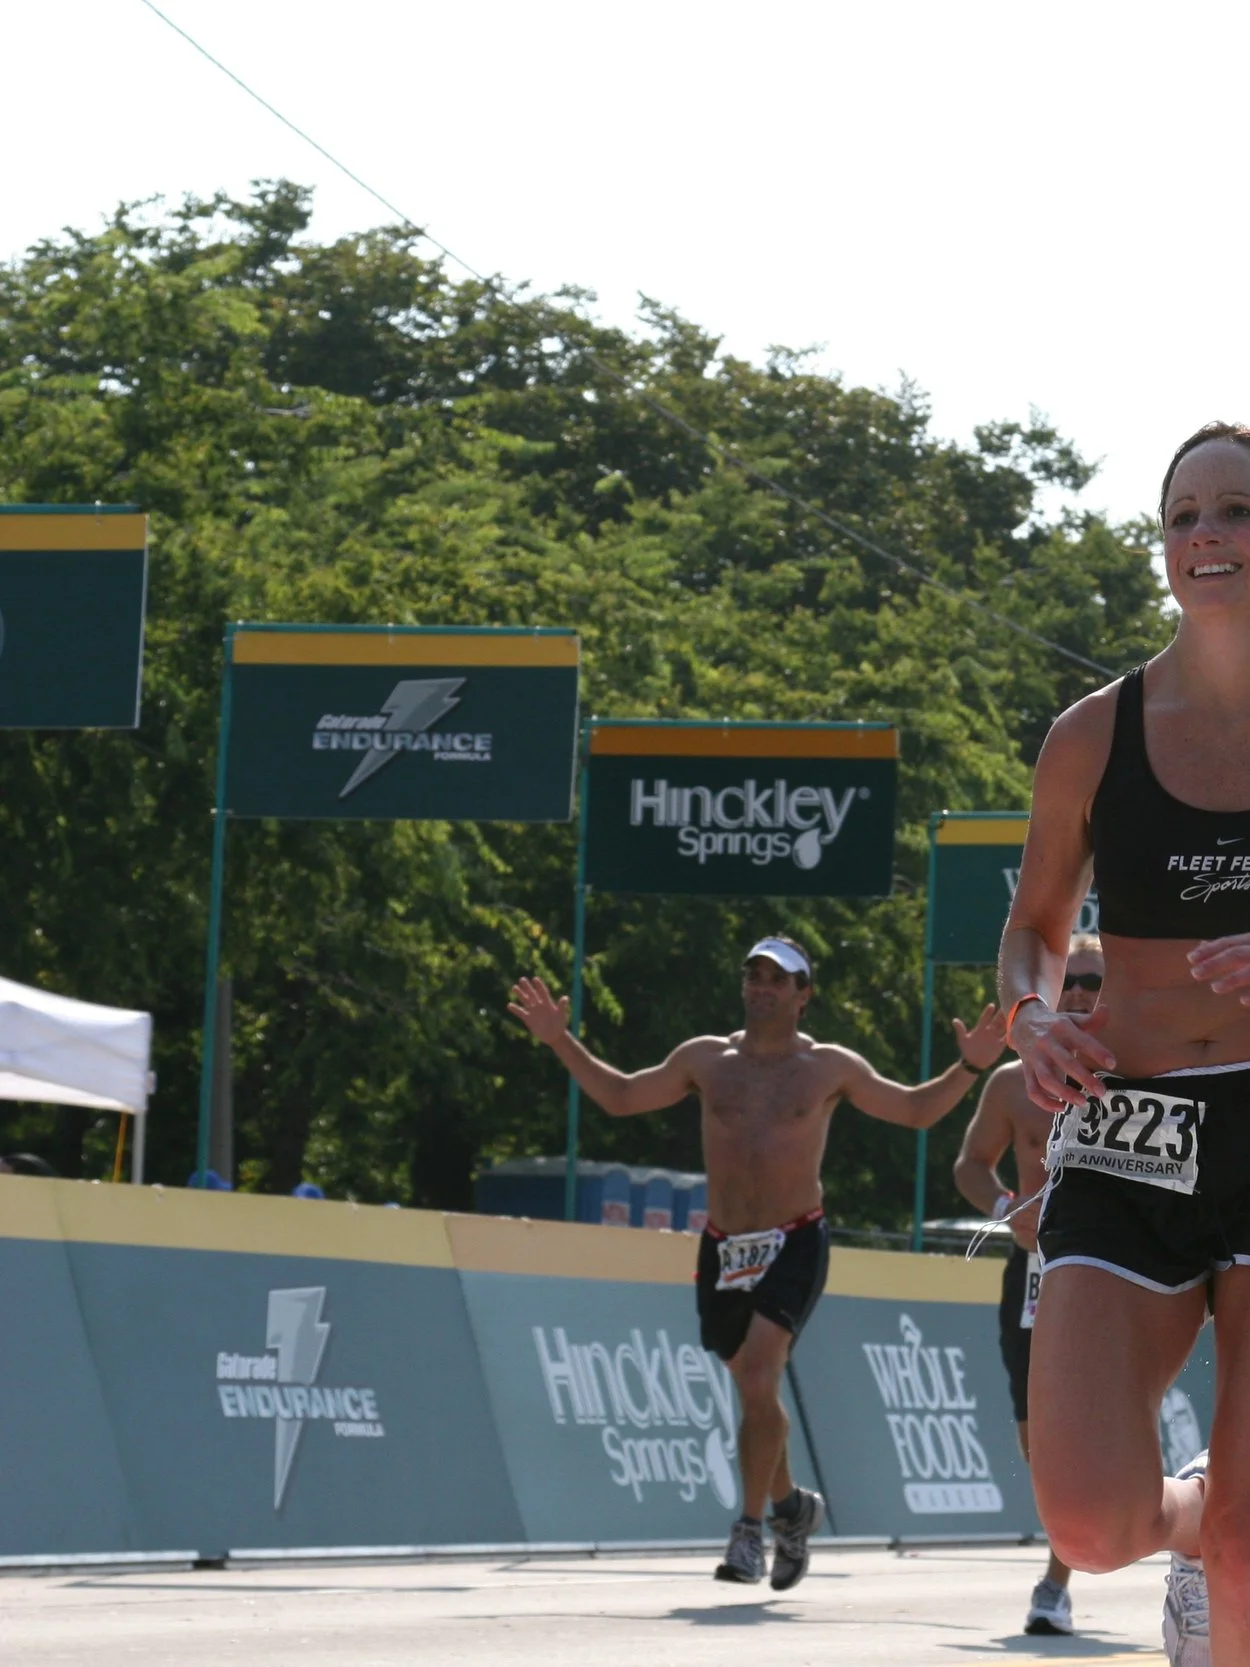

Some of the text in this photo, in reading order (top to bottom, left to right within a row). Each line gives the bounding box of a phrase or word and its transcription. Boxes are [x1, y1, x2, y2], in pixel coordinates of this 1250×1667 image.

[312, 731, 493, 751] ENDURANCE
[433, 752, 492, 762] FORMULA
[630, 779, 856, 845] Hinckley
[677, 826, 792, 866] Springs
[1167, 855, 1227, 872] FLEET
[1078, 1154, 1183, 1176] ANNIVERSARY
[531, 1326, 738, 1459] Hinckley
[862, 1343, 977, 1411] WHOLE
[217, 1384, 380, 1420] ENDURANCE
[333, 1422, 386, 1437] FORMULA
[884, 1413, 991, 1480] FOODS
[602, 1426, 708, 1503] Springs
